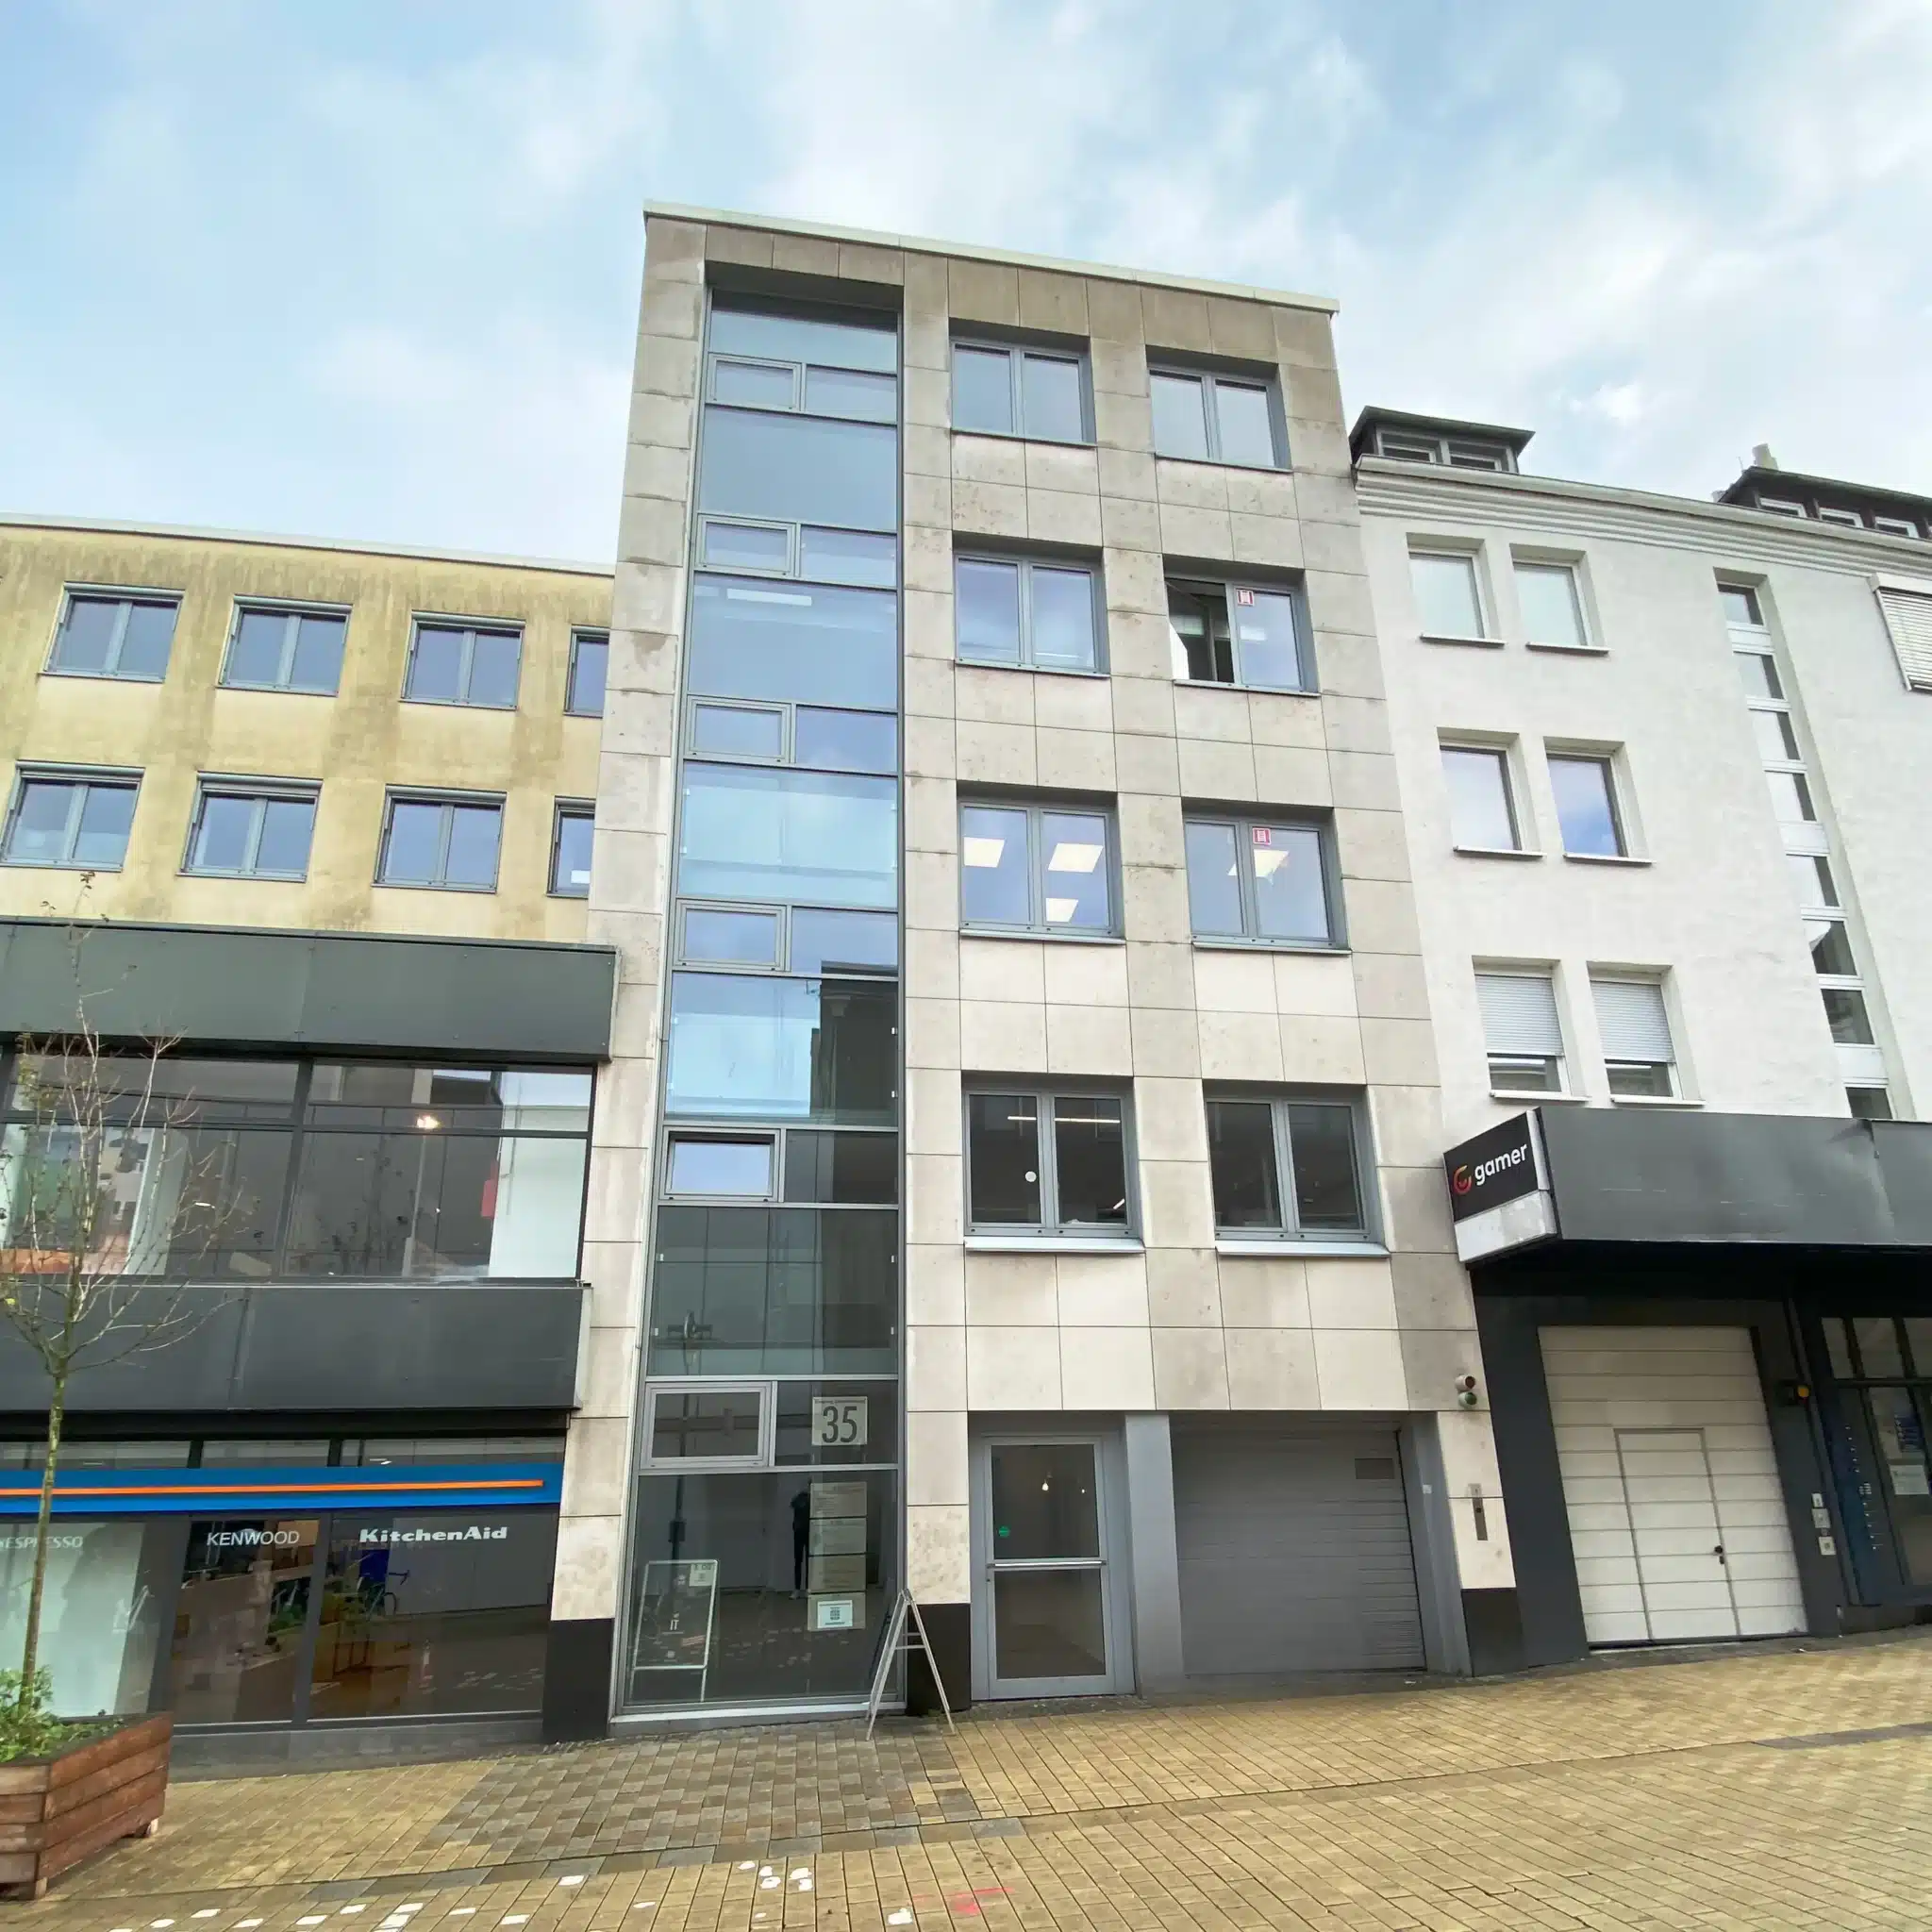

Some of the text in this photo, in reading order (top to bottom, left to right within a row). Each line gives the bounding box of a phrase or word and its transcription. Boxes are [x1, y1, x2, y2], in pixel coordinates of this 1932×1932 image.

[1474, 1143, 1527, 1186] gamer
[822, 1406, 858, 1443] 35
[207, 1530, 300, 1546] KENWOOD
[359, 1525, 508, 1542] KitchenAid
